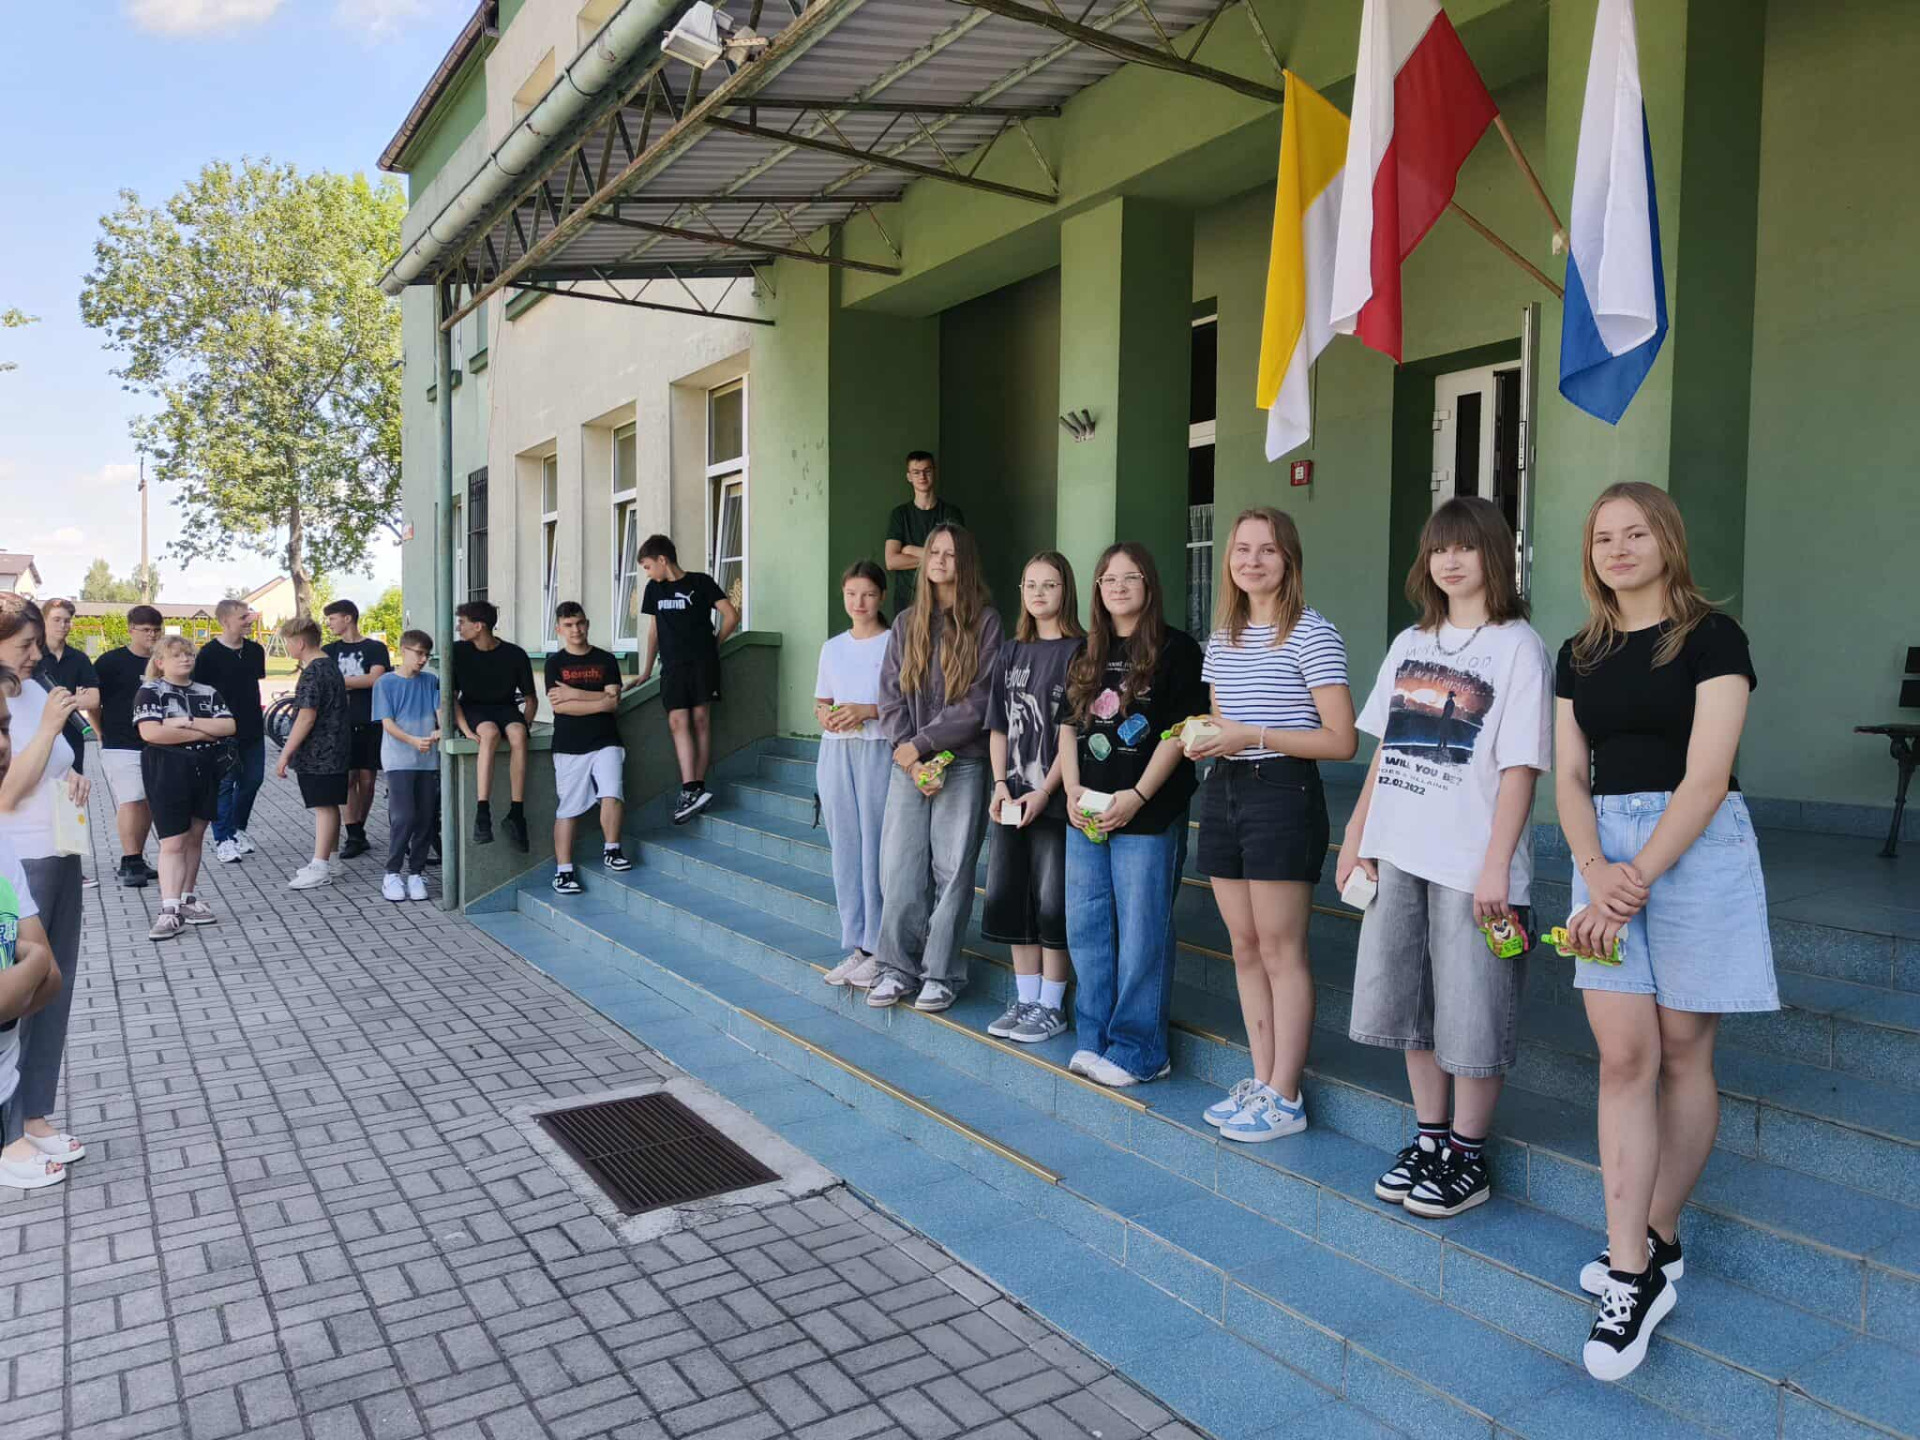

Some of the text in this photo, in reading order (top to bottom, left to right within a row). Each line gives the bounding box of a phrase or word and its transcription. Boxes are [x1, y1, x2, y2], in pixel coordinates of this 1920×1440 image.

[657, 599, 686, 611] PUMA
[1385, 756, 1410, 769] WILL
[1415, 764, 1438, 777] YOU
